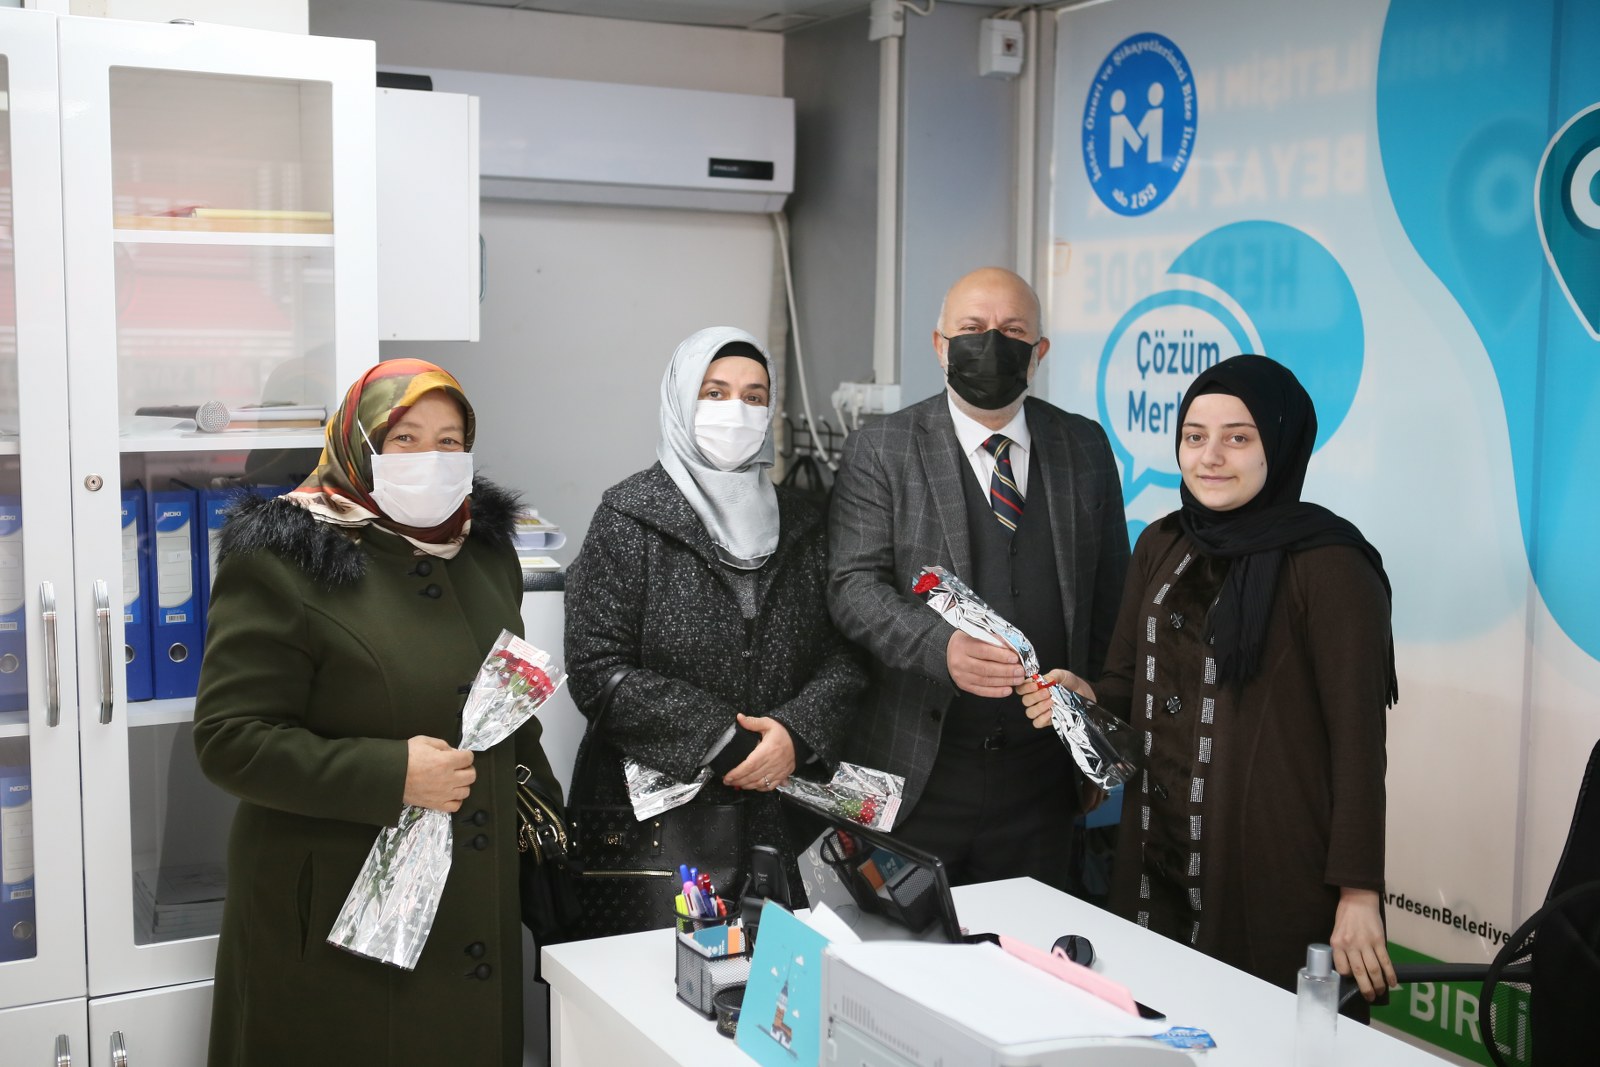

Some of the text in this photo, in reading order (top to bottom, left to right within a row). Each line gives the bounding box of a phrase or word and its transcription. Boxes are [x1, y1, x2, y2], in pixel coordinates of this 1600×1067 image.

[1181, 80, 1194, 121] Bize
[1131, 182, 1158, 210] 153
[1136, 329, 1220, 381] Çözüm
